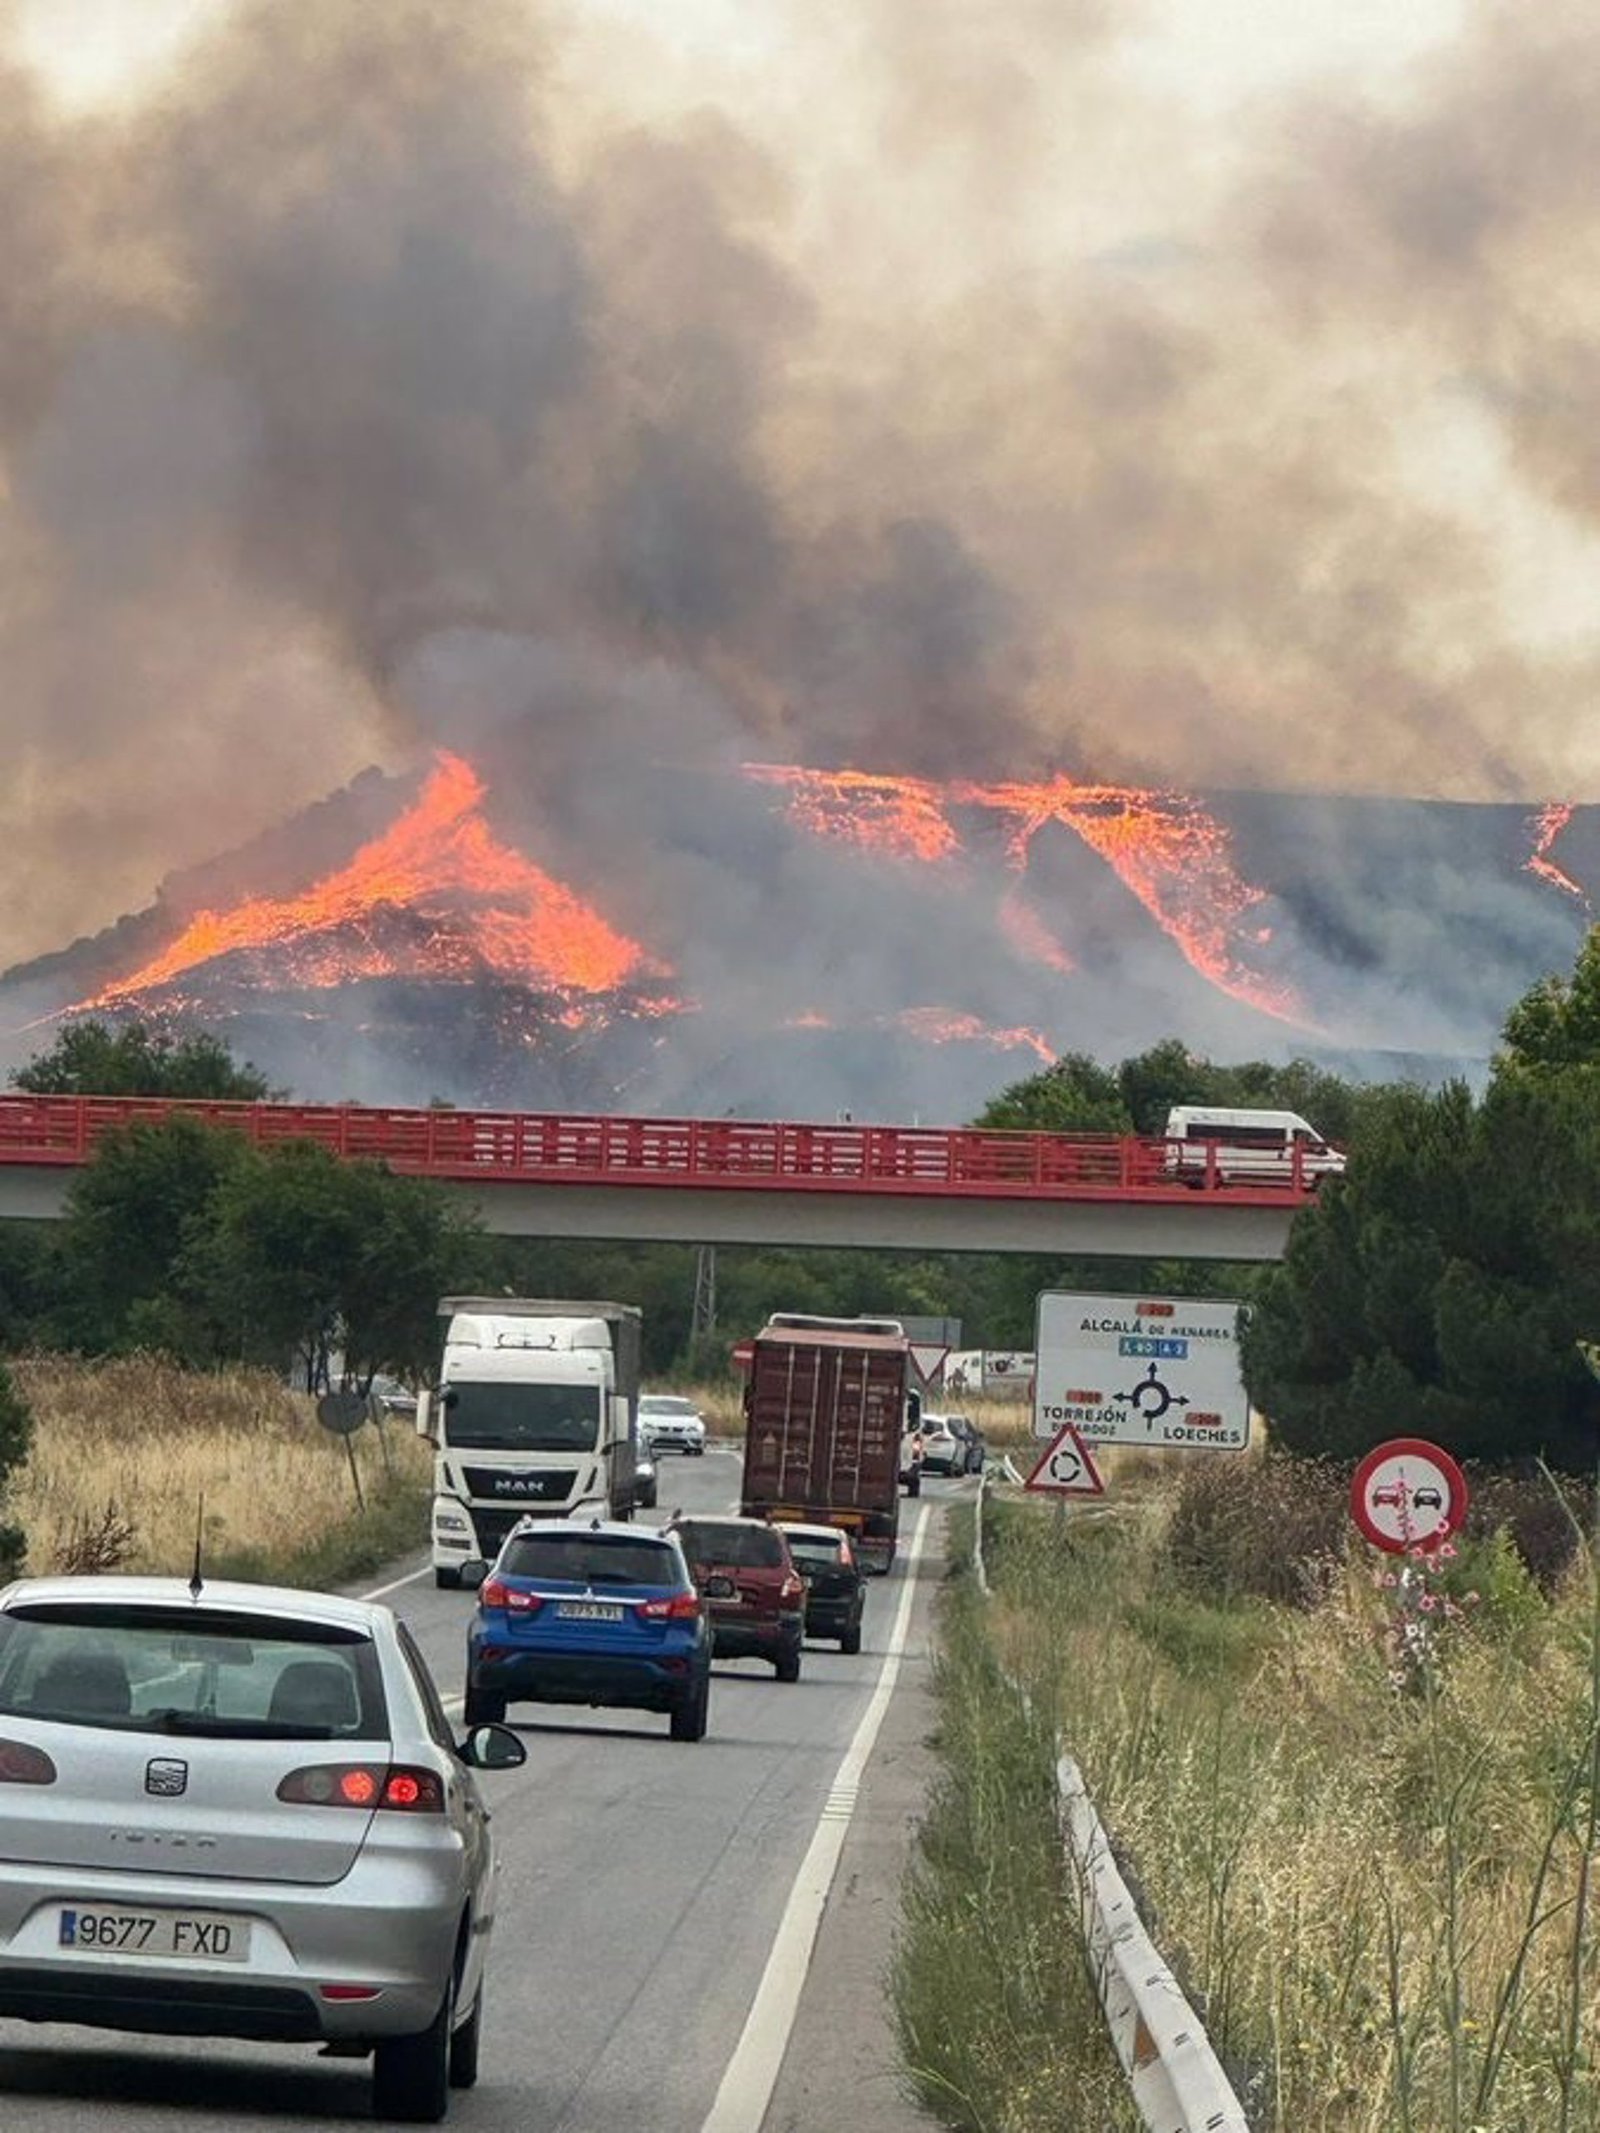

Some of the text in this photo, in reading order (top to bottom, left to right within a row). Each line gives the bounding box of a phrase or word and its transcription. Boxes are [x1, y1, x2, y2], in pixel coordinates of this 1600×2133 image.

[1080, 1318, 1143, 1334] ALCALÁ
[1149, 1326, 1165, 1336] DE
[1043, 1405, 1127, 1424] TORREJÓN
[1164, 1427, 1241, 1444] LOECHES
[495, 1480, 544, 1492] MAN
[80, 1914, 232, 1955] 9677 FXD
